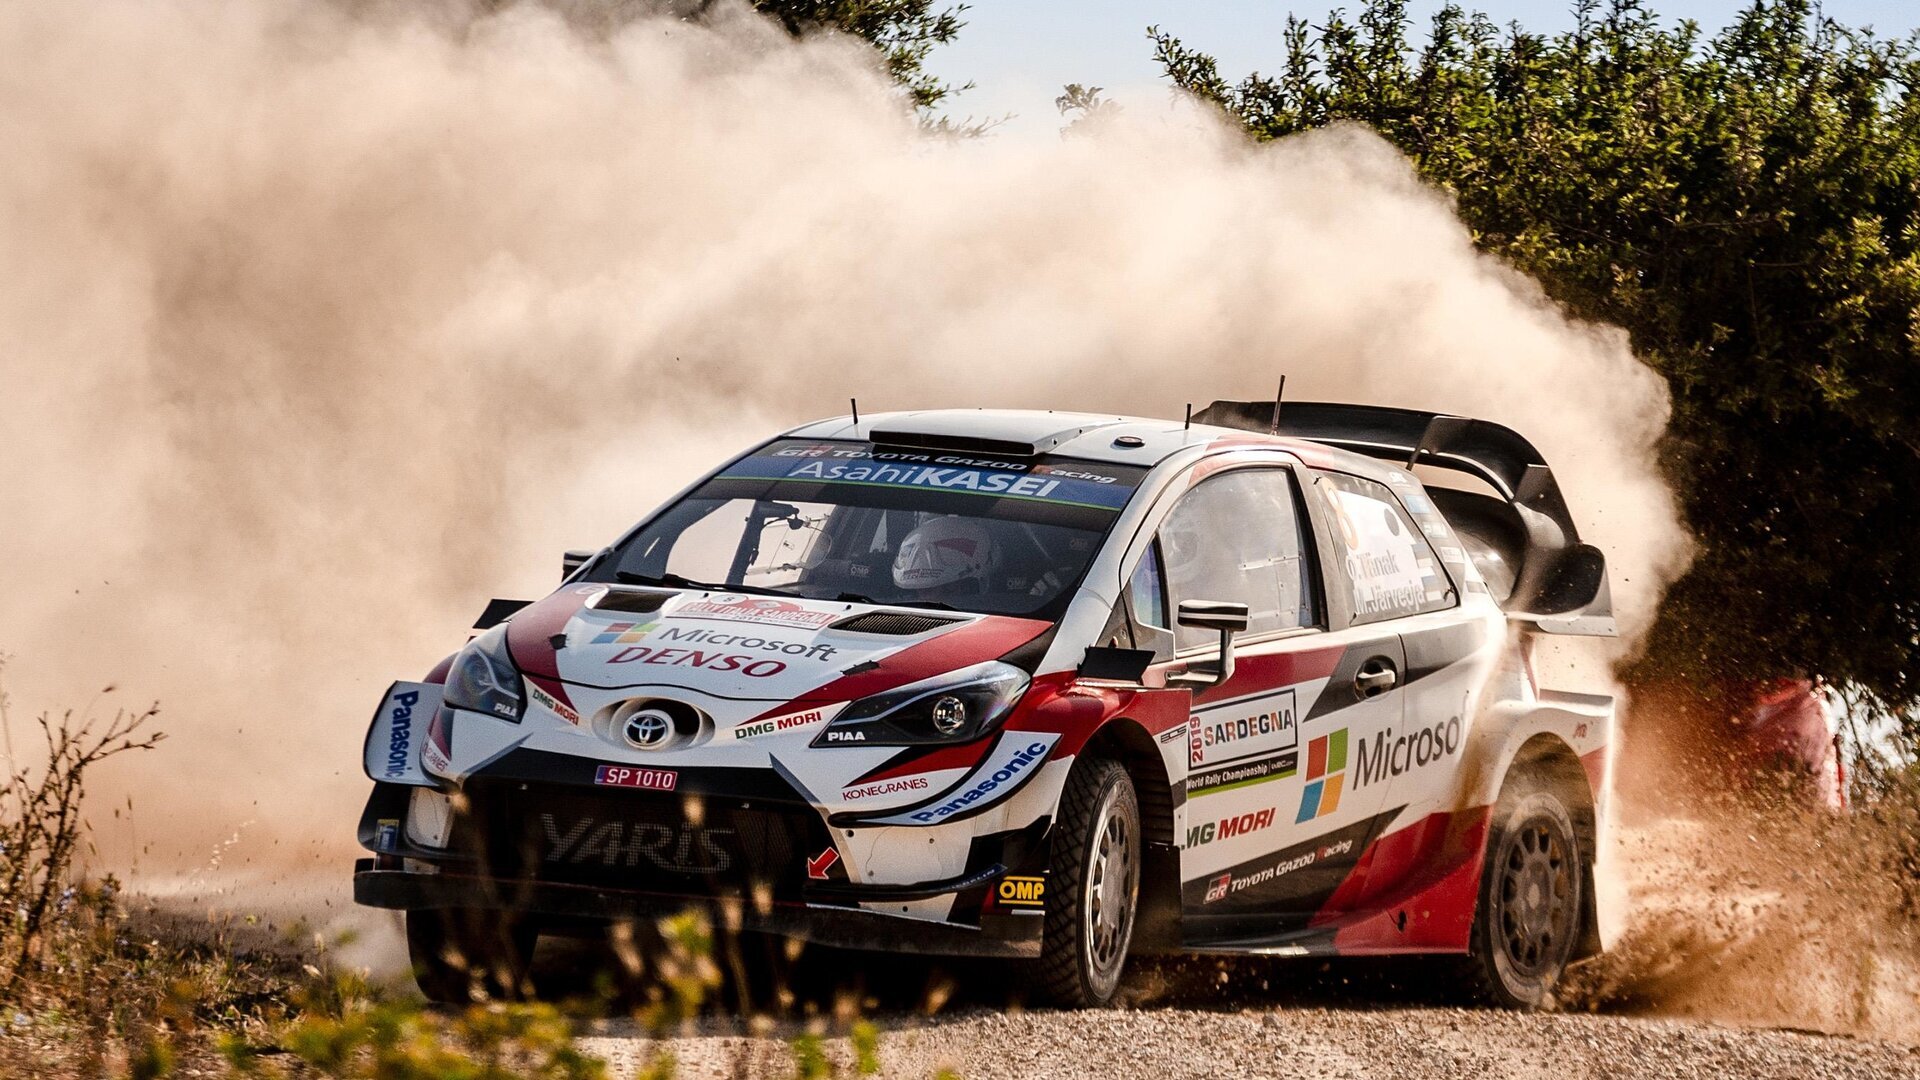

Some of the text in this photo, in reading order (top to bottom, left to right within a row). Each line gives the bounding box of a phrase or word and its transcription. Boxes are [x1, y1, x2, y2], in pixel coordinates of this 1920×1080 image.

[833, 450, 928, 462] TOYOTA
[934, 456, 1027, 471] GAZOO
[787, 461, 1061, 497] AsahiKASEI
[720, 606, 758, 617] ITALIA
[760, 608, 833, 625] SARDEGNA
[658, 627, 838, 662] Microsoft
[606, 646, 787, 678] DENSO
[494, 702, 518, 717] PIAA
[553, 700, 579, 726] MORI
[384, 690, 419, 779] Panasonic
[734, 710, 822, 741] DMG MORI
[828, 730, 866, 742] PIAA
[1189, 709, 1293, 763] 2019 SARDEGNA
[1353, 714, 1463, 791] Microso
[606, 768, 674, 789] SP 1010
[910, 742, 1047, 823] Panasonic
[1205, 773, 1221, 785] Rally
[1222, 763, 1268, 782] Championship
[842, 778, 929, 802] KONECRANES
[540, 812, 736, 875] YARIS
[1181, 807, 1277, 851] MG MORI
[999, 881, 1045, 900] OMP
[1205, 885, 1228, 901] GR
[1231, 868, 1274, 892] TOYOTA
[1276, 852, 1316, 877] GAZOO
